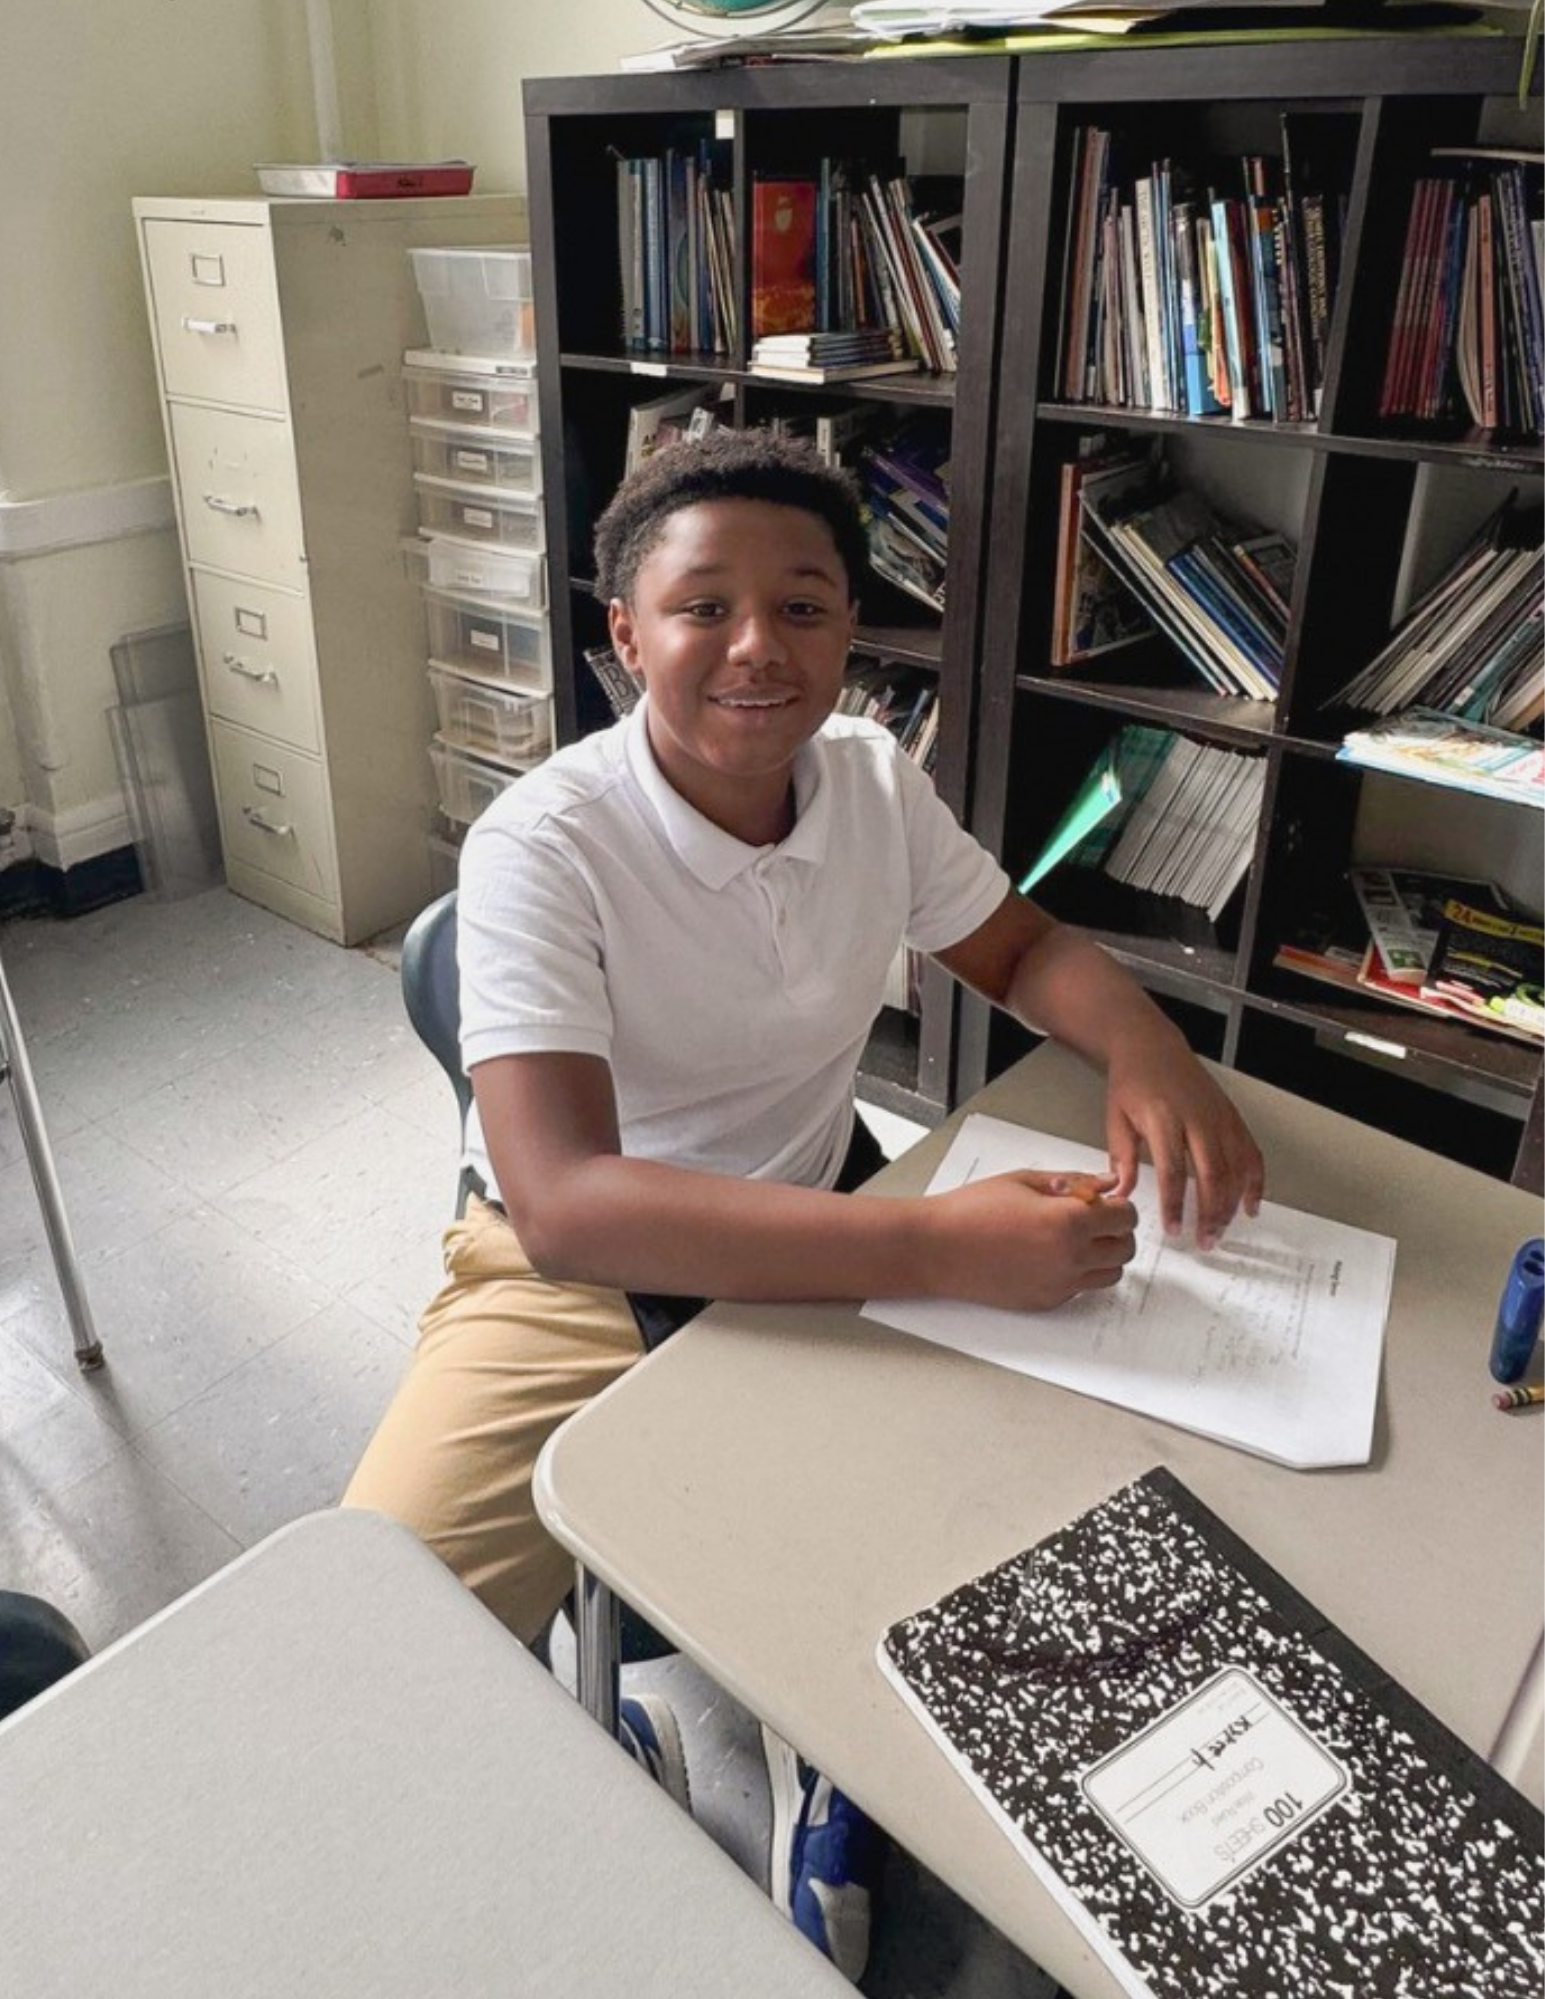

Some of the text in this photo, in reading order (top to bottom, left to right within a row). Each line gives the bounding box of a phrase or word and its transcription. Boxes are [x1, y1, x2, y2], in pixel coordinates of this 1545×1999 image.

[1198, 1757, 1264, 1814] Composition
[1213, 1792, 1303, 1863] 100 SHEETS
